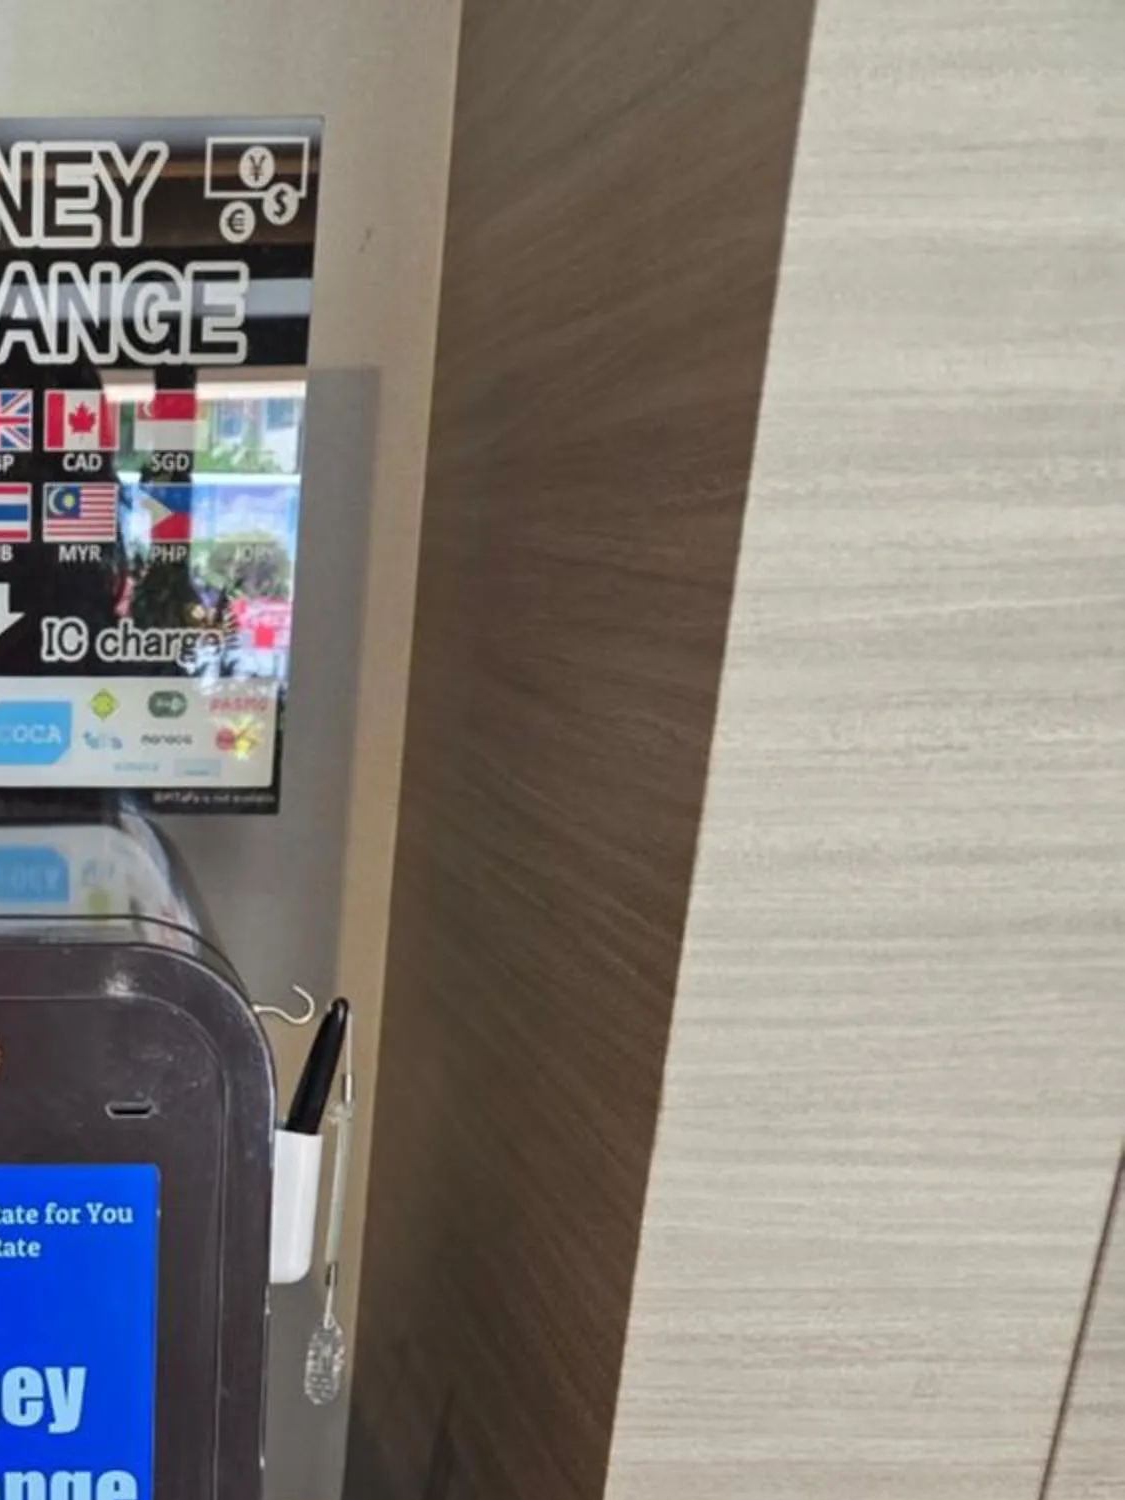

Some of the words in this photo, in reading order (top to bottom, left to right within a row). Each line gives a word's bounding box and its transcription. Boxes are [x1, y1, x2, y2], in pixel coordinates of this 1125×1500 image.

[62, 454, 103, 471] CAD
[150, 453, 190, 472] SGD
[58, 545, 103, 562] MYR
[150, 545, 187, 562] PHP
[40, 617, 89, 663] IC
[96, 619, 223, 668] charge
[44, 1202, 80, 1225] for
[85, 1202, 135, 1225] You
